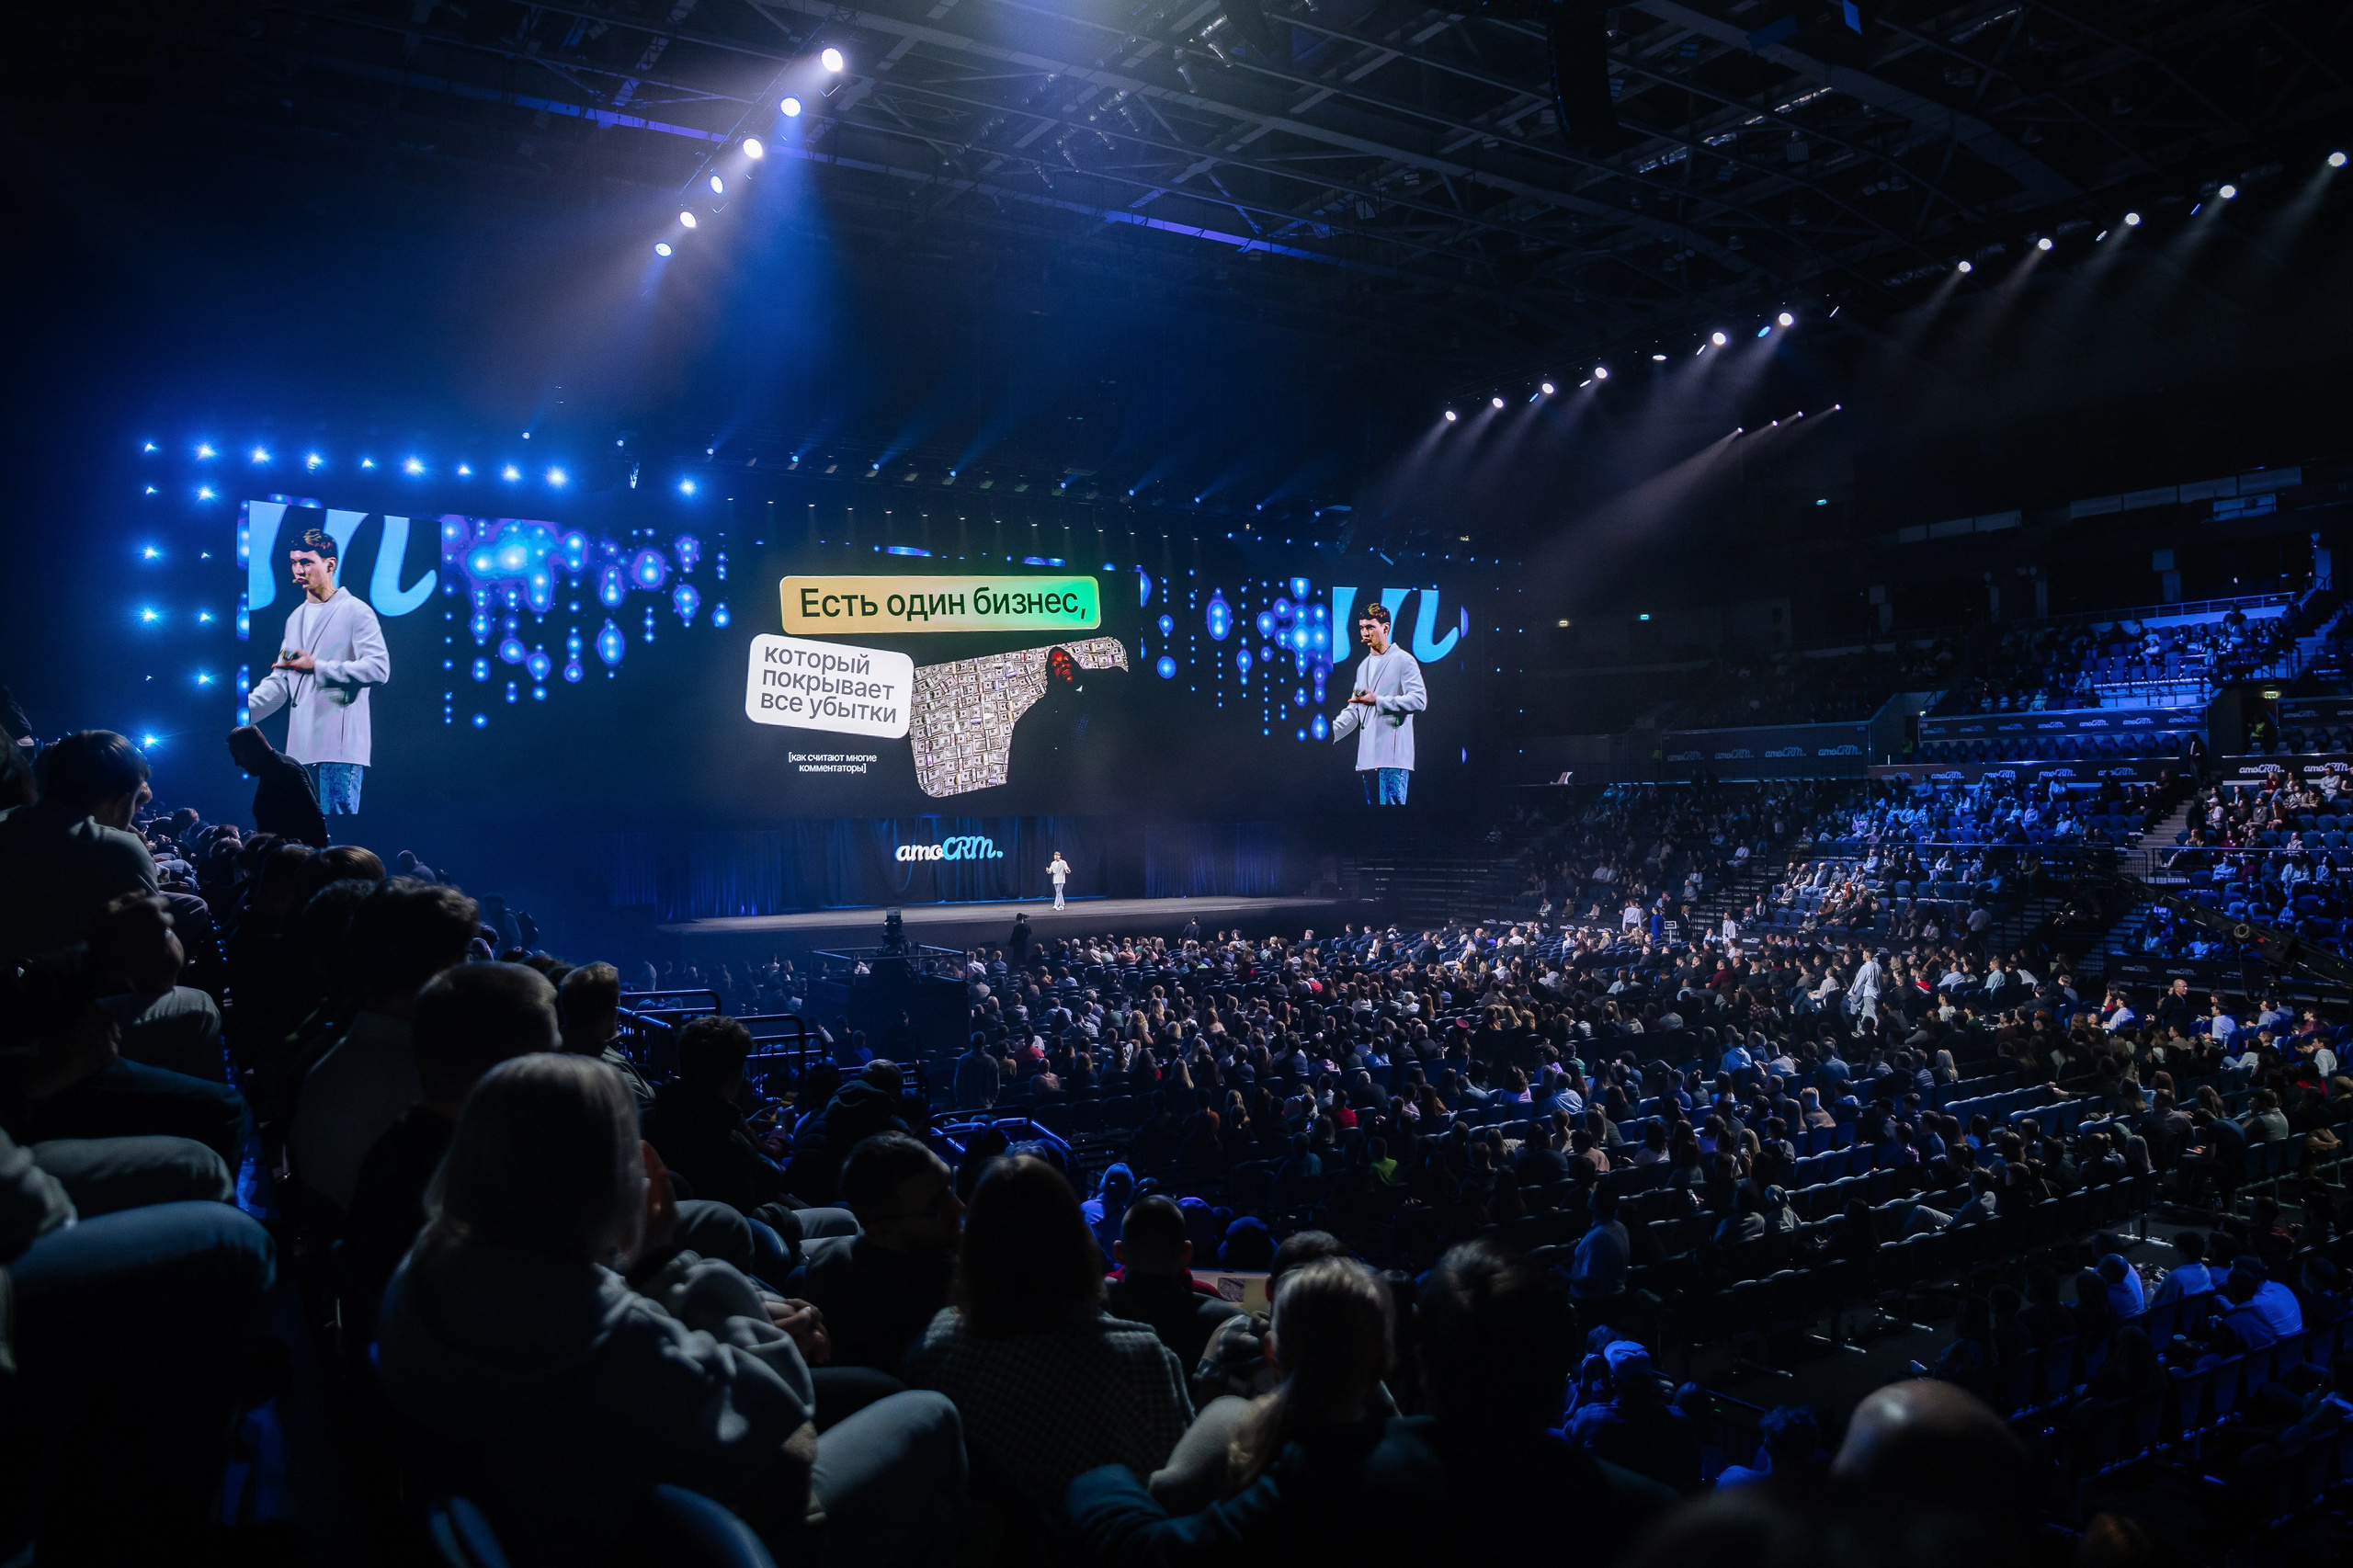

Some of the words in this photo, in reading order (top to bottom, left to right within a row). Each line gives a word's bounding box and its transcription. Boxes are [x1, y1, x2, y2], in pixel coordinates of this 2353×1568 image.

[800, 587, 879, 618] Есть
[887, 592, 965, 622] один
[973, 586, 1086, 619] бизнес,
[765, 646, 870, 676] который
[763, 669, 894, 700] покрывает
[760, 692, 803, 712] все
[809, 696, 897, 723] убытки
[789, 751, 807, 763] [как
[807, 754, 845, 762] считают
[846, 754, 878, 762] многие
[799, 762, 867, 774] комментаторы]
